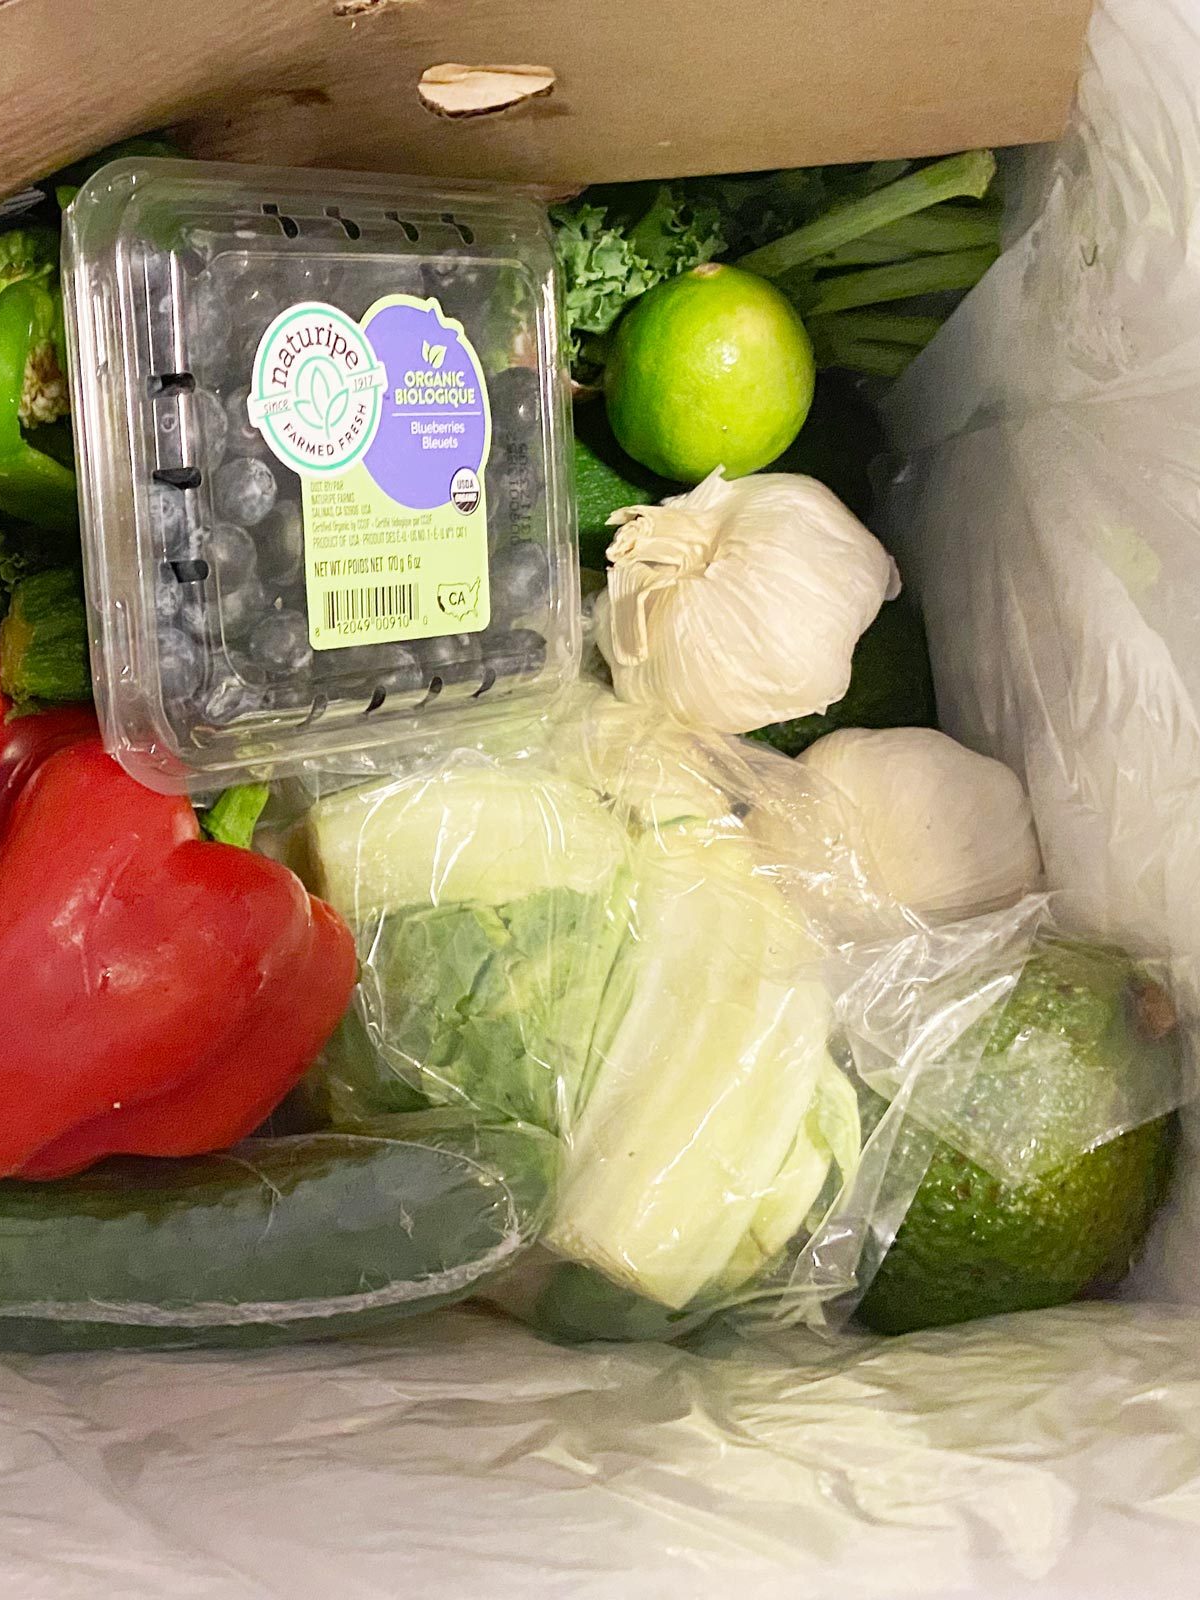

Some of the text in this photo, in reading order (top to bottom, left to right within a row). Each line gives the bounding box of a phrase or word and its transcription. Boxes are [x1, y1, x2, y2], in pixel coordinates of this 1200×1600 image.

[272, 323, 359, 388] naturipe
[404, 371, 465, 388] ORGANIC
[264, 375, 374, 415] since 1917
[395, 388, 475, 408] BIOLOGIQUE
[283, 404, 366, 456] FARMED FRESH
[410, 421, 466, 435] Blueberries
[422, 436, 459, 450] Bleuets
[456, 479, 474, 490] USDA
[314, 561, 328, 577] NET
[330, 560, 341, 576] WT
[347, 557, 369, 575] POIDS
[370, 556, 383, 573] NET
[388, 555, 398, 571] 170
[407, 554, 413, 569] 6
[448, 591, 465, 606] CA
[314, 627, 320, 637] 8
[337, 619, 370, 635] 12049
[375, 614, 410, 631] 00910
